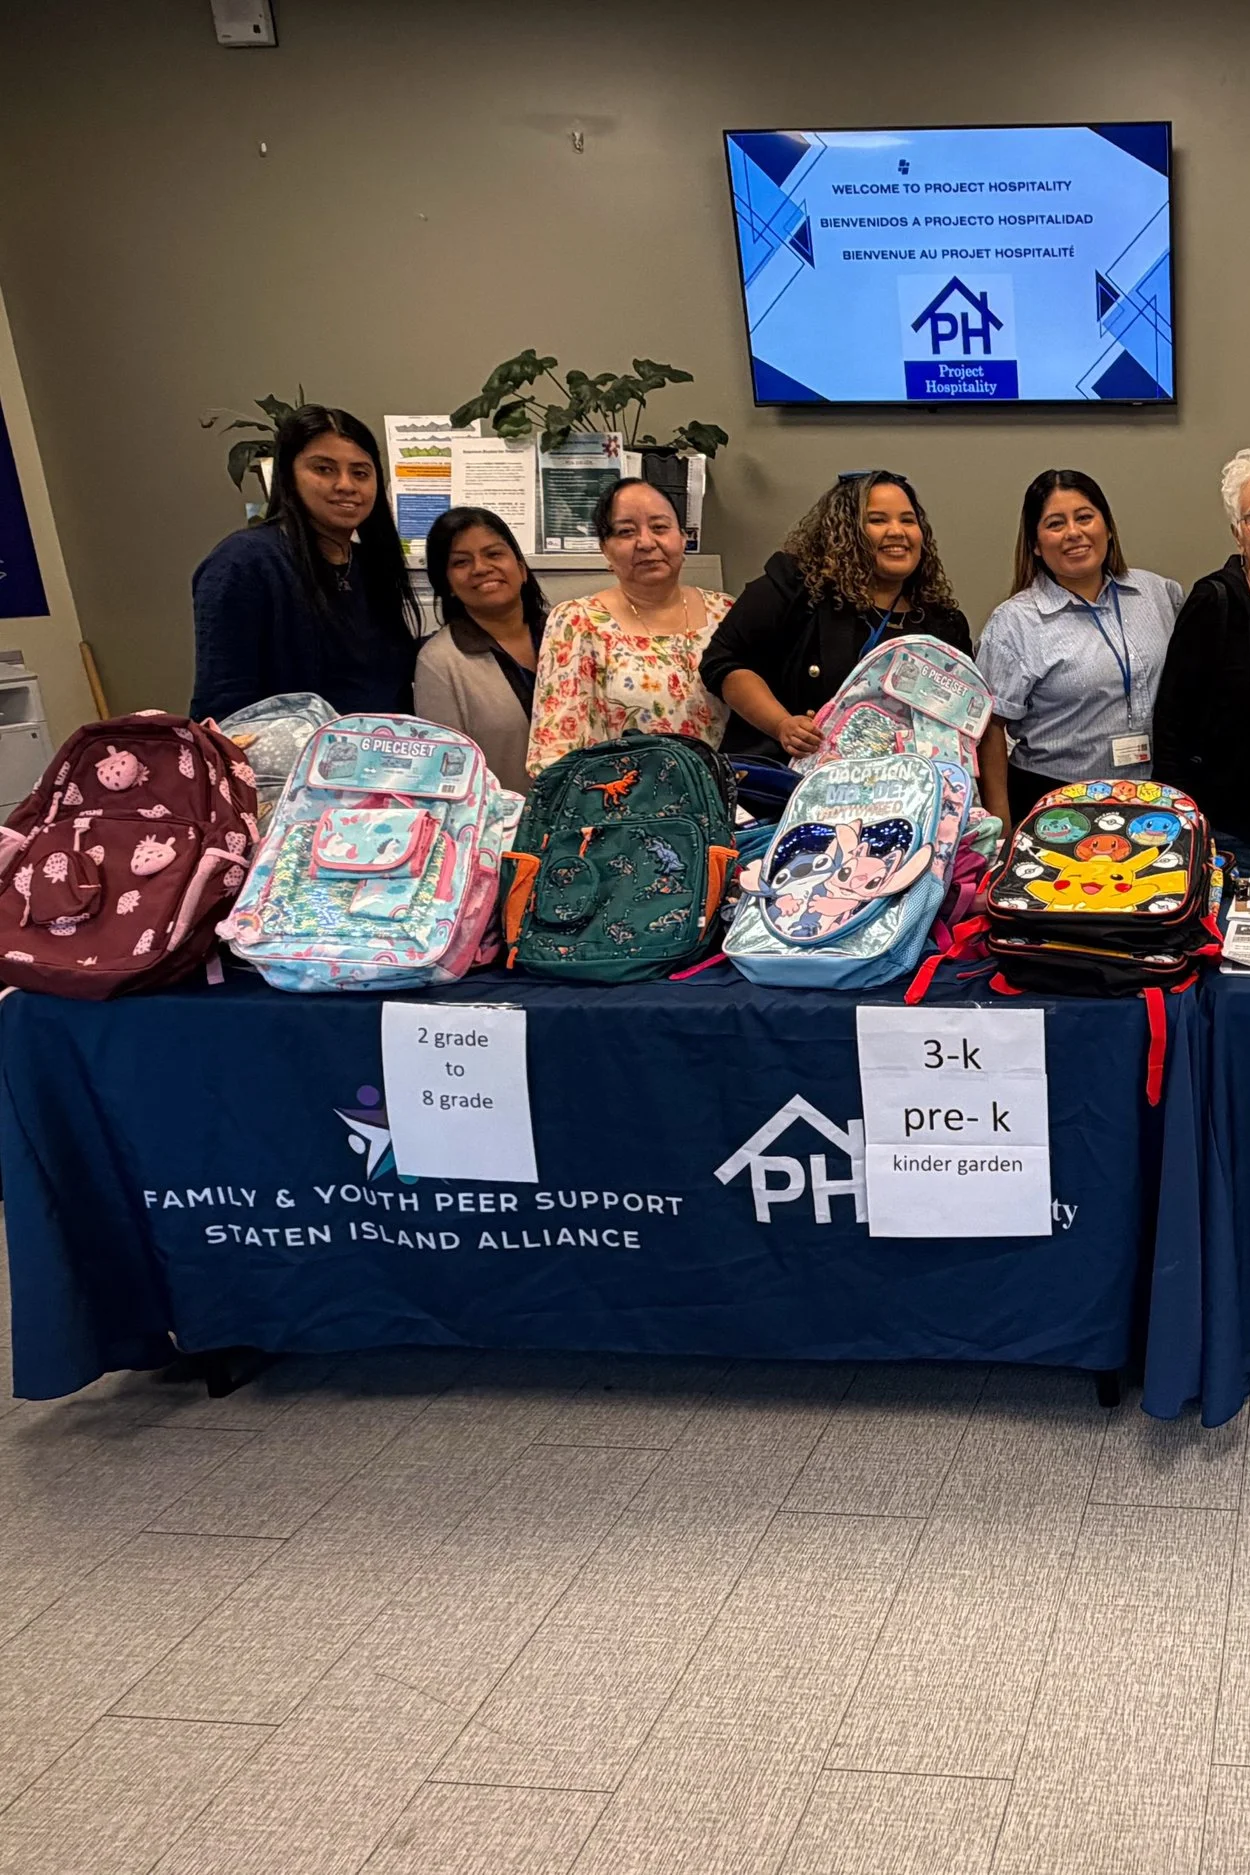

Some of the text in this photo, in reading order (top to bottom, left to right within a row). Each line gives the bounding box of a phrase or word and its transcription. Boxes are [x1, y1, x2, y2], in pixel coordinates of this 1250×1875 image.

[832, 180, 1072, 195] WELCOME TO PROJECT HOSPITALITY
[820, 214, 1094, 228] BIENVENIDOS A PROJECTO HOSPITALIDAD
[842, 244, 1075, 261] BIENVENUE AU PROJET HOSPITALITÉ
[930, 311, 991, 355] PH
[938, 364, 985, 380] Project
[925, 379, 998, 396] Hospitality
[921, 665, 969, 697] 6 PIECE SET
[361, 737, 437, 758] 6 PIECE SET
[418, 1027, 489, 1048] 2 grade
[923, 1037, 982, 1070] 3-k
[445, 1061, 465, 1077] to
[422, 1090, 494, 1110] 8 grade
[904, 1101, 1012, 1137] pre- k
[893, 1154, 1023, 1175] kinder garden
[749, 1153, 869, 1224] PH
[143, 1184, 683, 1216] FAMILY & YOUTH PEER SUPPORT
[205, 1221, 642, 1250] STATEN ISLAND ALLIANCE
